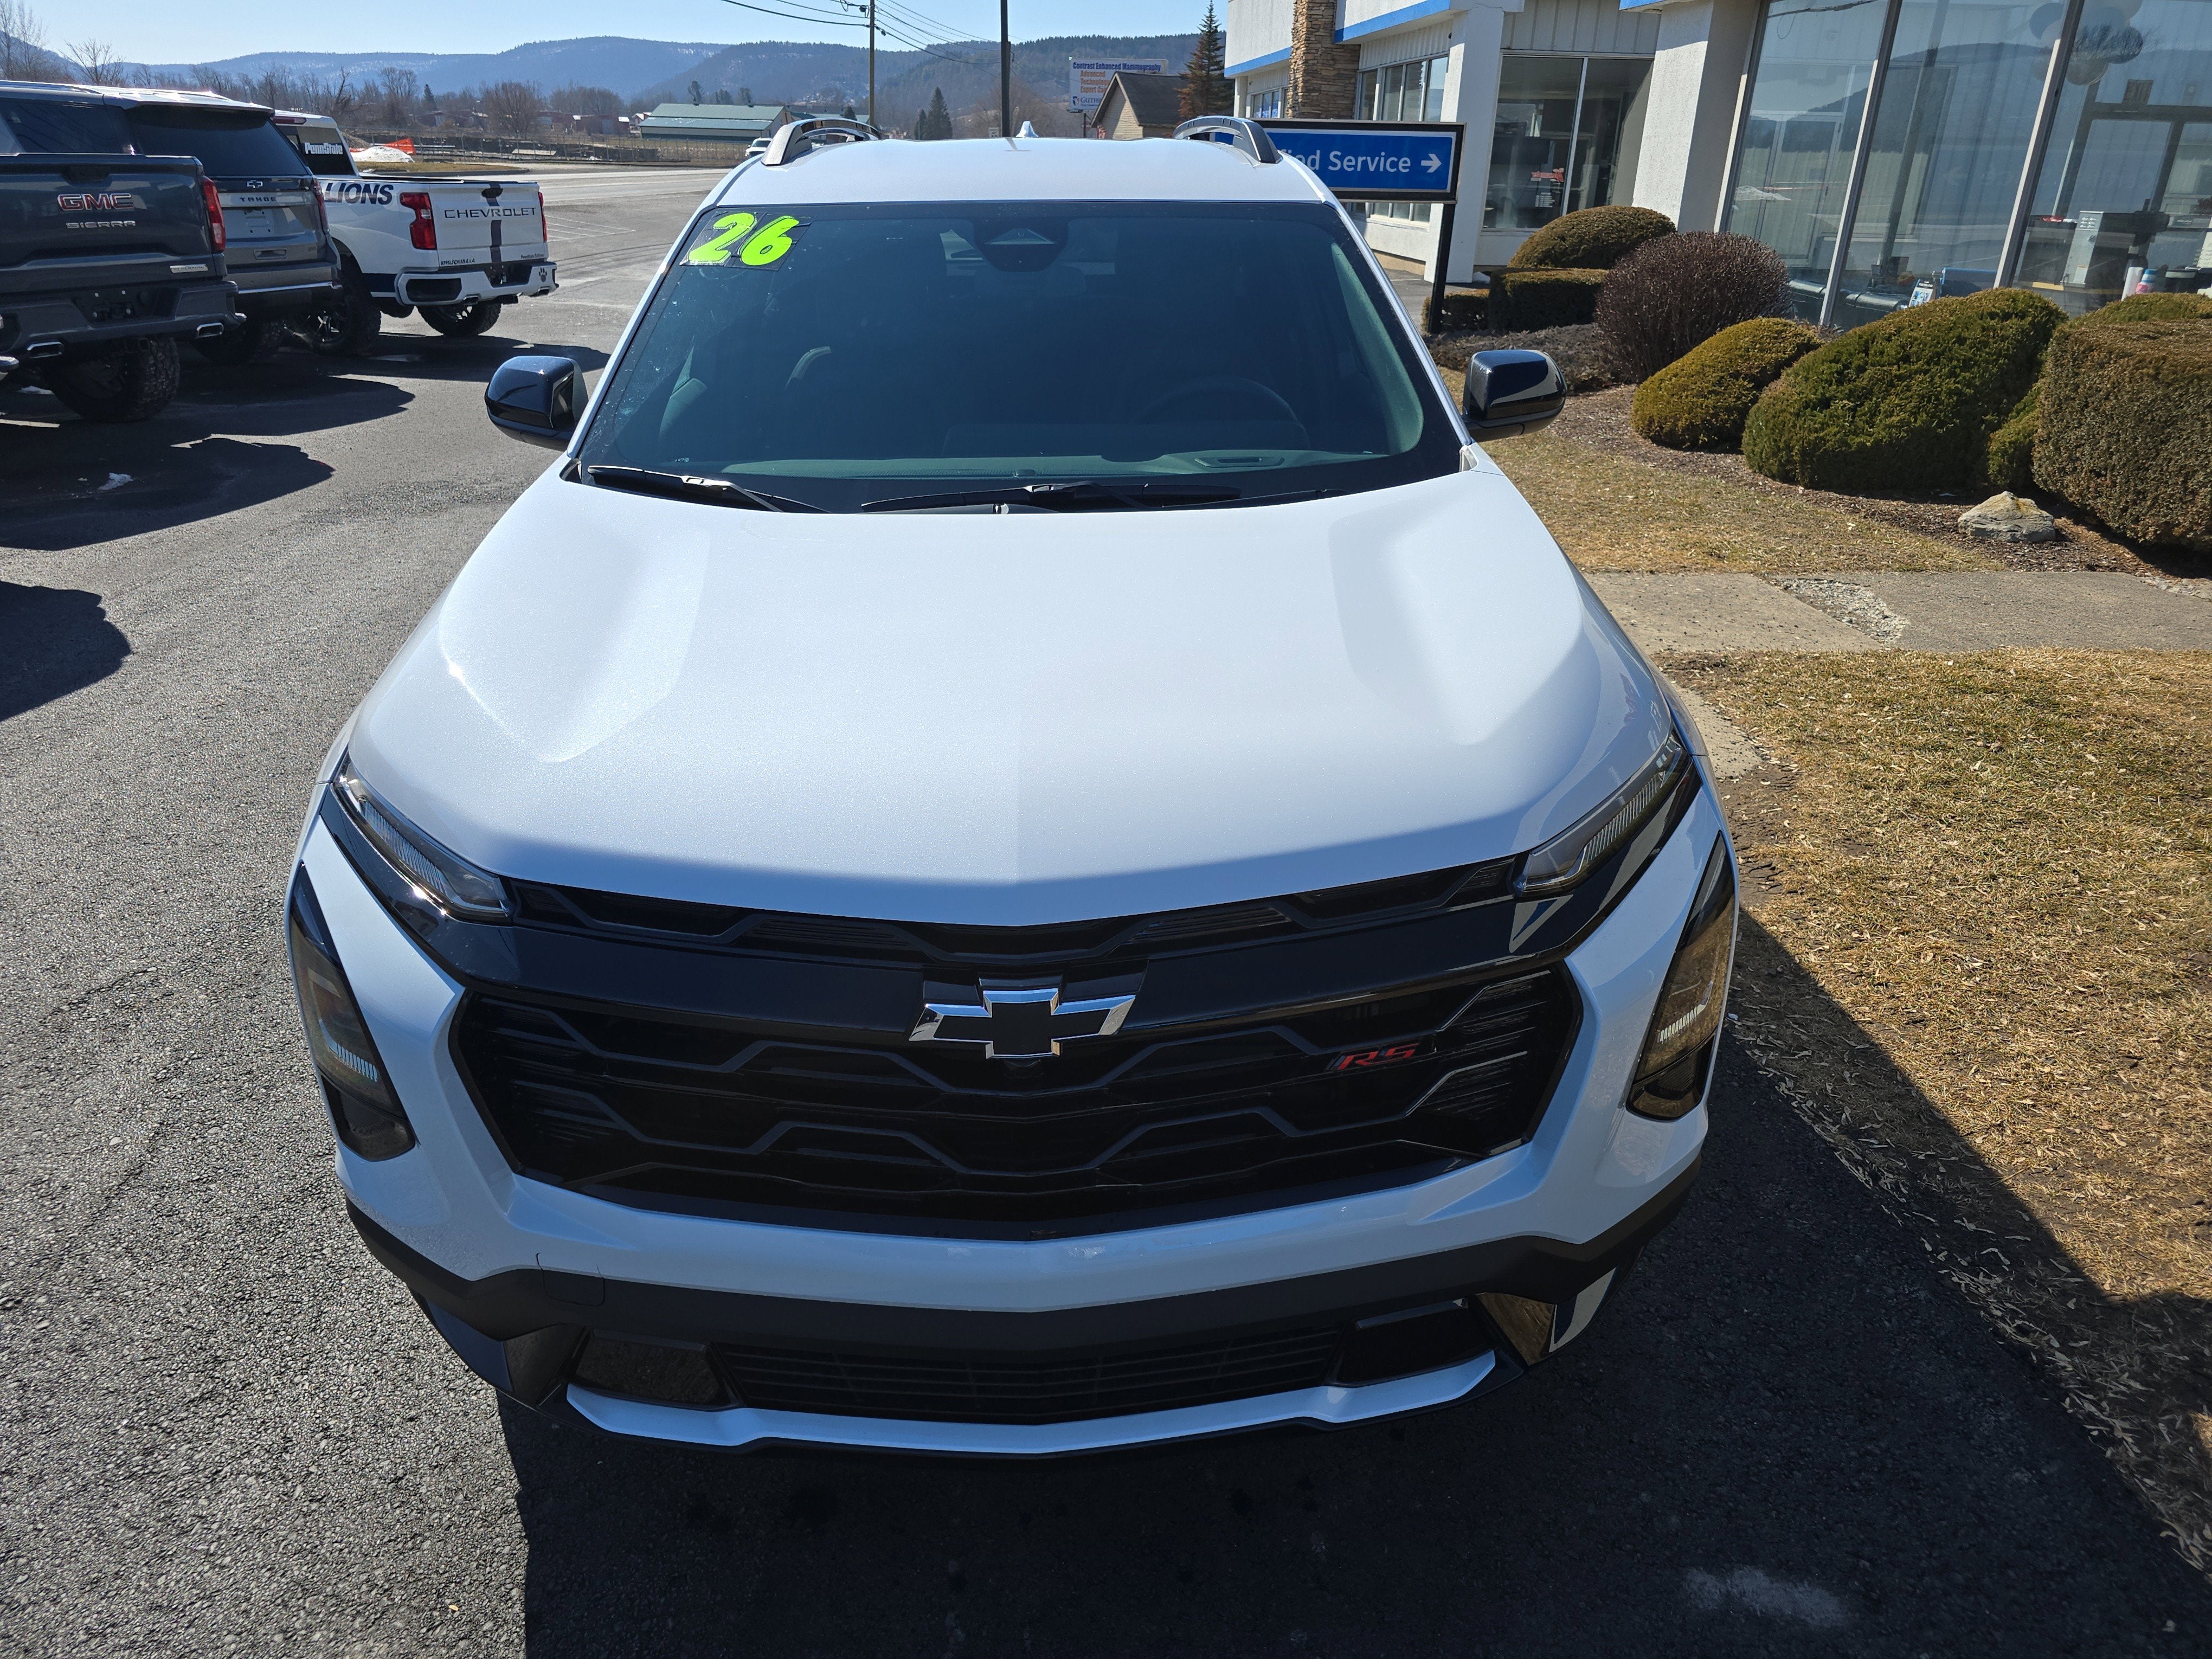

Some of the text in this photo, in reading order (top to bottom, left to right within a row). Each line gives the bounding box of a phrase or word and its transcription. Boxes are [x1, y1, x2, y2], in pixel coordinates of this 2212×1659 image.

[1122, 63, 1161, 72] Mammography
[1328, 151, 1411, 172] Service
[57, 193, 134, 211] GMC
[324, 183, 394, 205] LIONS
[444, 207, 537, 218] CHEVROLET
[66, 220, 136, 229] SIERRA
[689, 212, 800, 266] 26
[1337, 1042, 1420, 1071] RS
